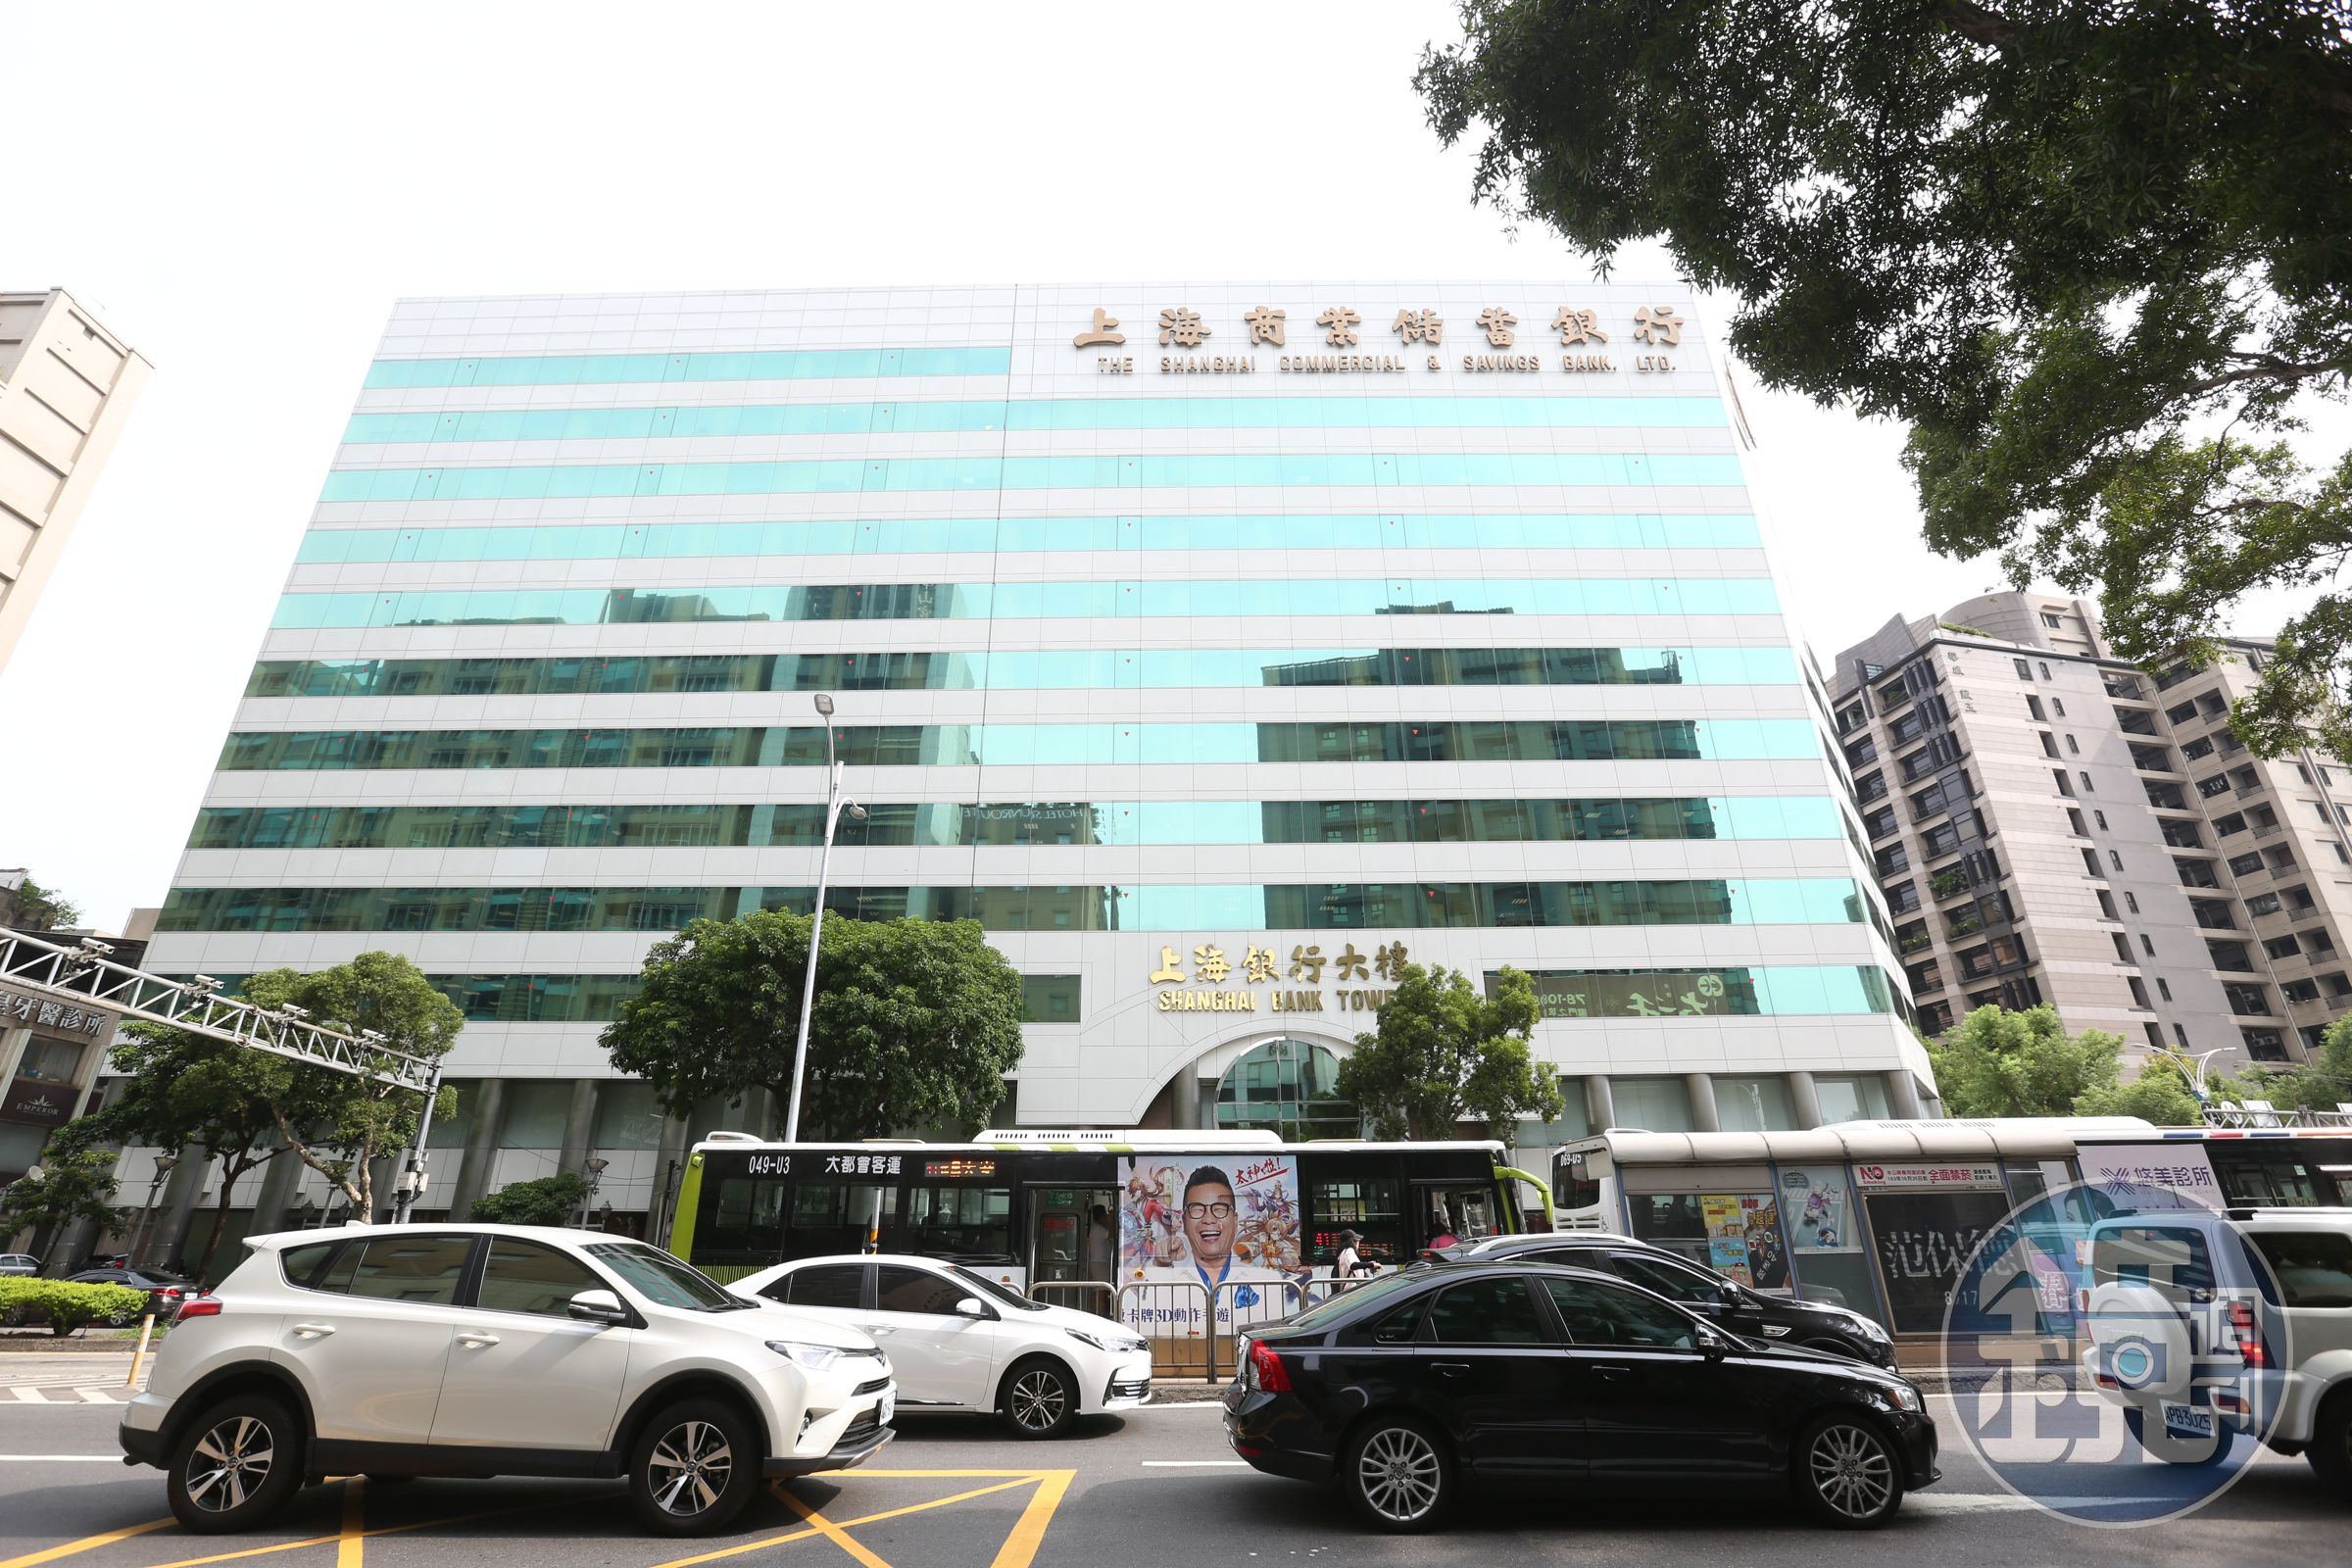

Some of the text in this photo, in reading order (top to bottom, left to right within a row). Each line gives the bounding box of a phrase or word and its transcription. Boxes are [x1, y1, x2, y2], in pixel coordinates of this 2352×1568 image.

[1072, 305, 1685, 349] 上海商業儲蓄銀行
[1098, 356, 1134, 373] THE
[1160, 356, 1257, 373] SHANGHAI
[1280, 356, 1406, 372] COMMERCIAL
[1427, 356, 1442, 371] &
[1463, 356, 1540, 372] SAVINGS
[1635, 355, 1678, 372] LTD.
[1149, 940, 1409, 984] 上海銀行大樓
[1158, 990, 1255, 1012] SHANGHAI
[1271, 990, 1324, 1011] BANK
[17, 1102, 60, 1115] EMPEROR
[748, 1155, 791, 1175] 049-U3
[825, 1155, 902, 1175] 大都會客運
[1928, 1169, 1973, 1181] 全面禁菸
[2133, 1166, 2212, 1187] 悠美診所
